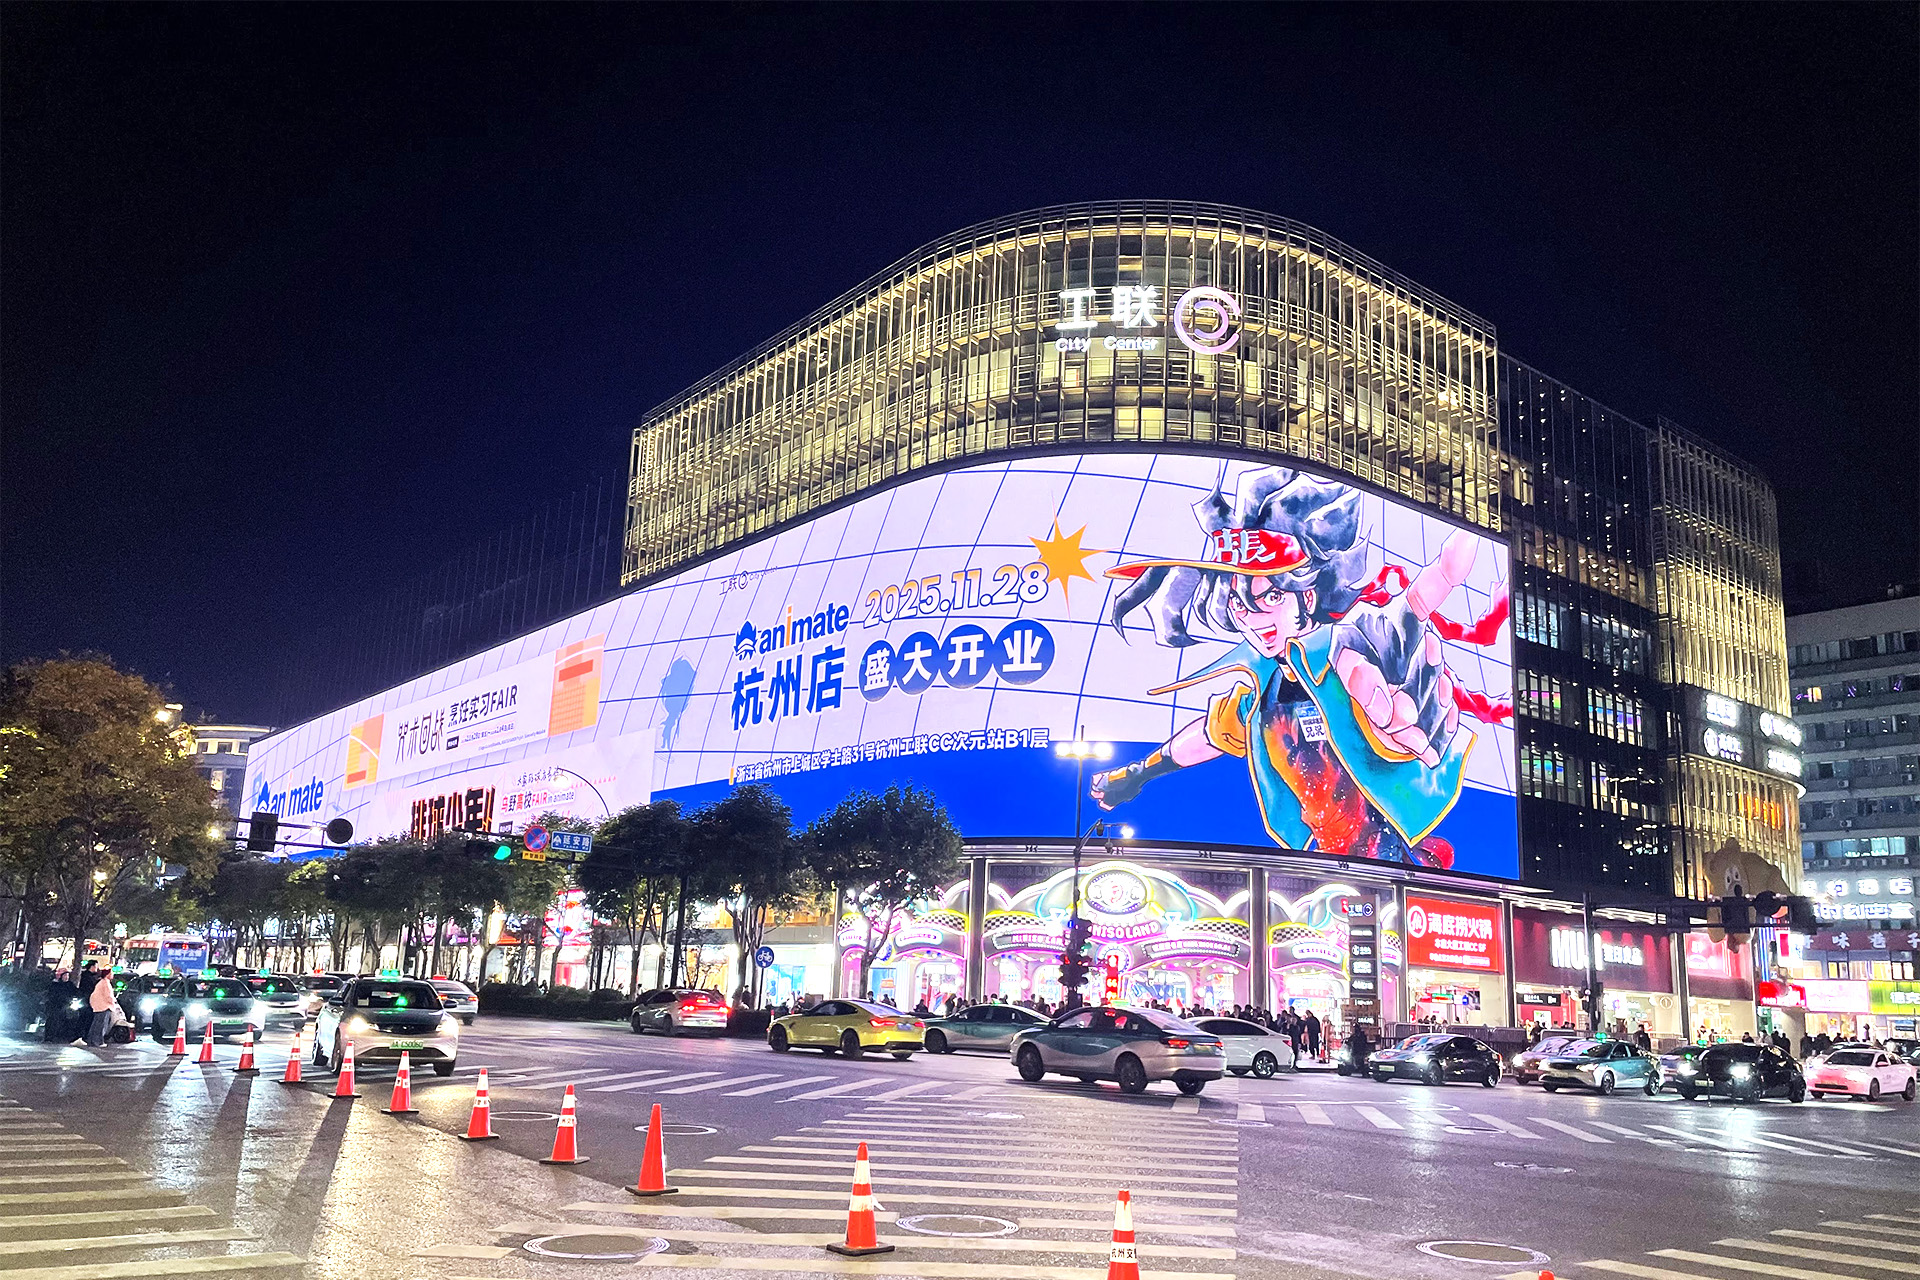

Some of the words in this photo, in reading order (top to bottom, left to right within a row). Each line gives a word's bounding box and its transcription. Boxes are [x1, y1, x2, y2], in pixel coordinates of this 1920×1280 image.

[1055, 285, 1158, 330] 工联
[1055, 336, 1091, 352] City
[1103, 335, 1158, 351] Center
[863, 562, 1050, 629] 2025.11.28
[760, 602, 850, 655] animate
[864, 629, 1044, 692] 盛大开业
[448, 684, 518, 727] 烹饪实习FAIR
[731, 645, 846, 731] 杭州店
[270, 770, 324, 819] animate
[563, 834, 590, 847] 延安路
[1125, 921, 1159, 939] LAND
[1428, 912, 1493, 940] 海底捞火锅
[1603, 943, 1643, 966] 无印良品
[1111, 1247, 1137, 1259] 杭州交
